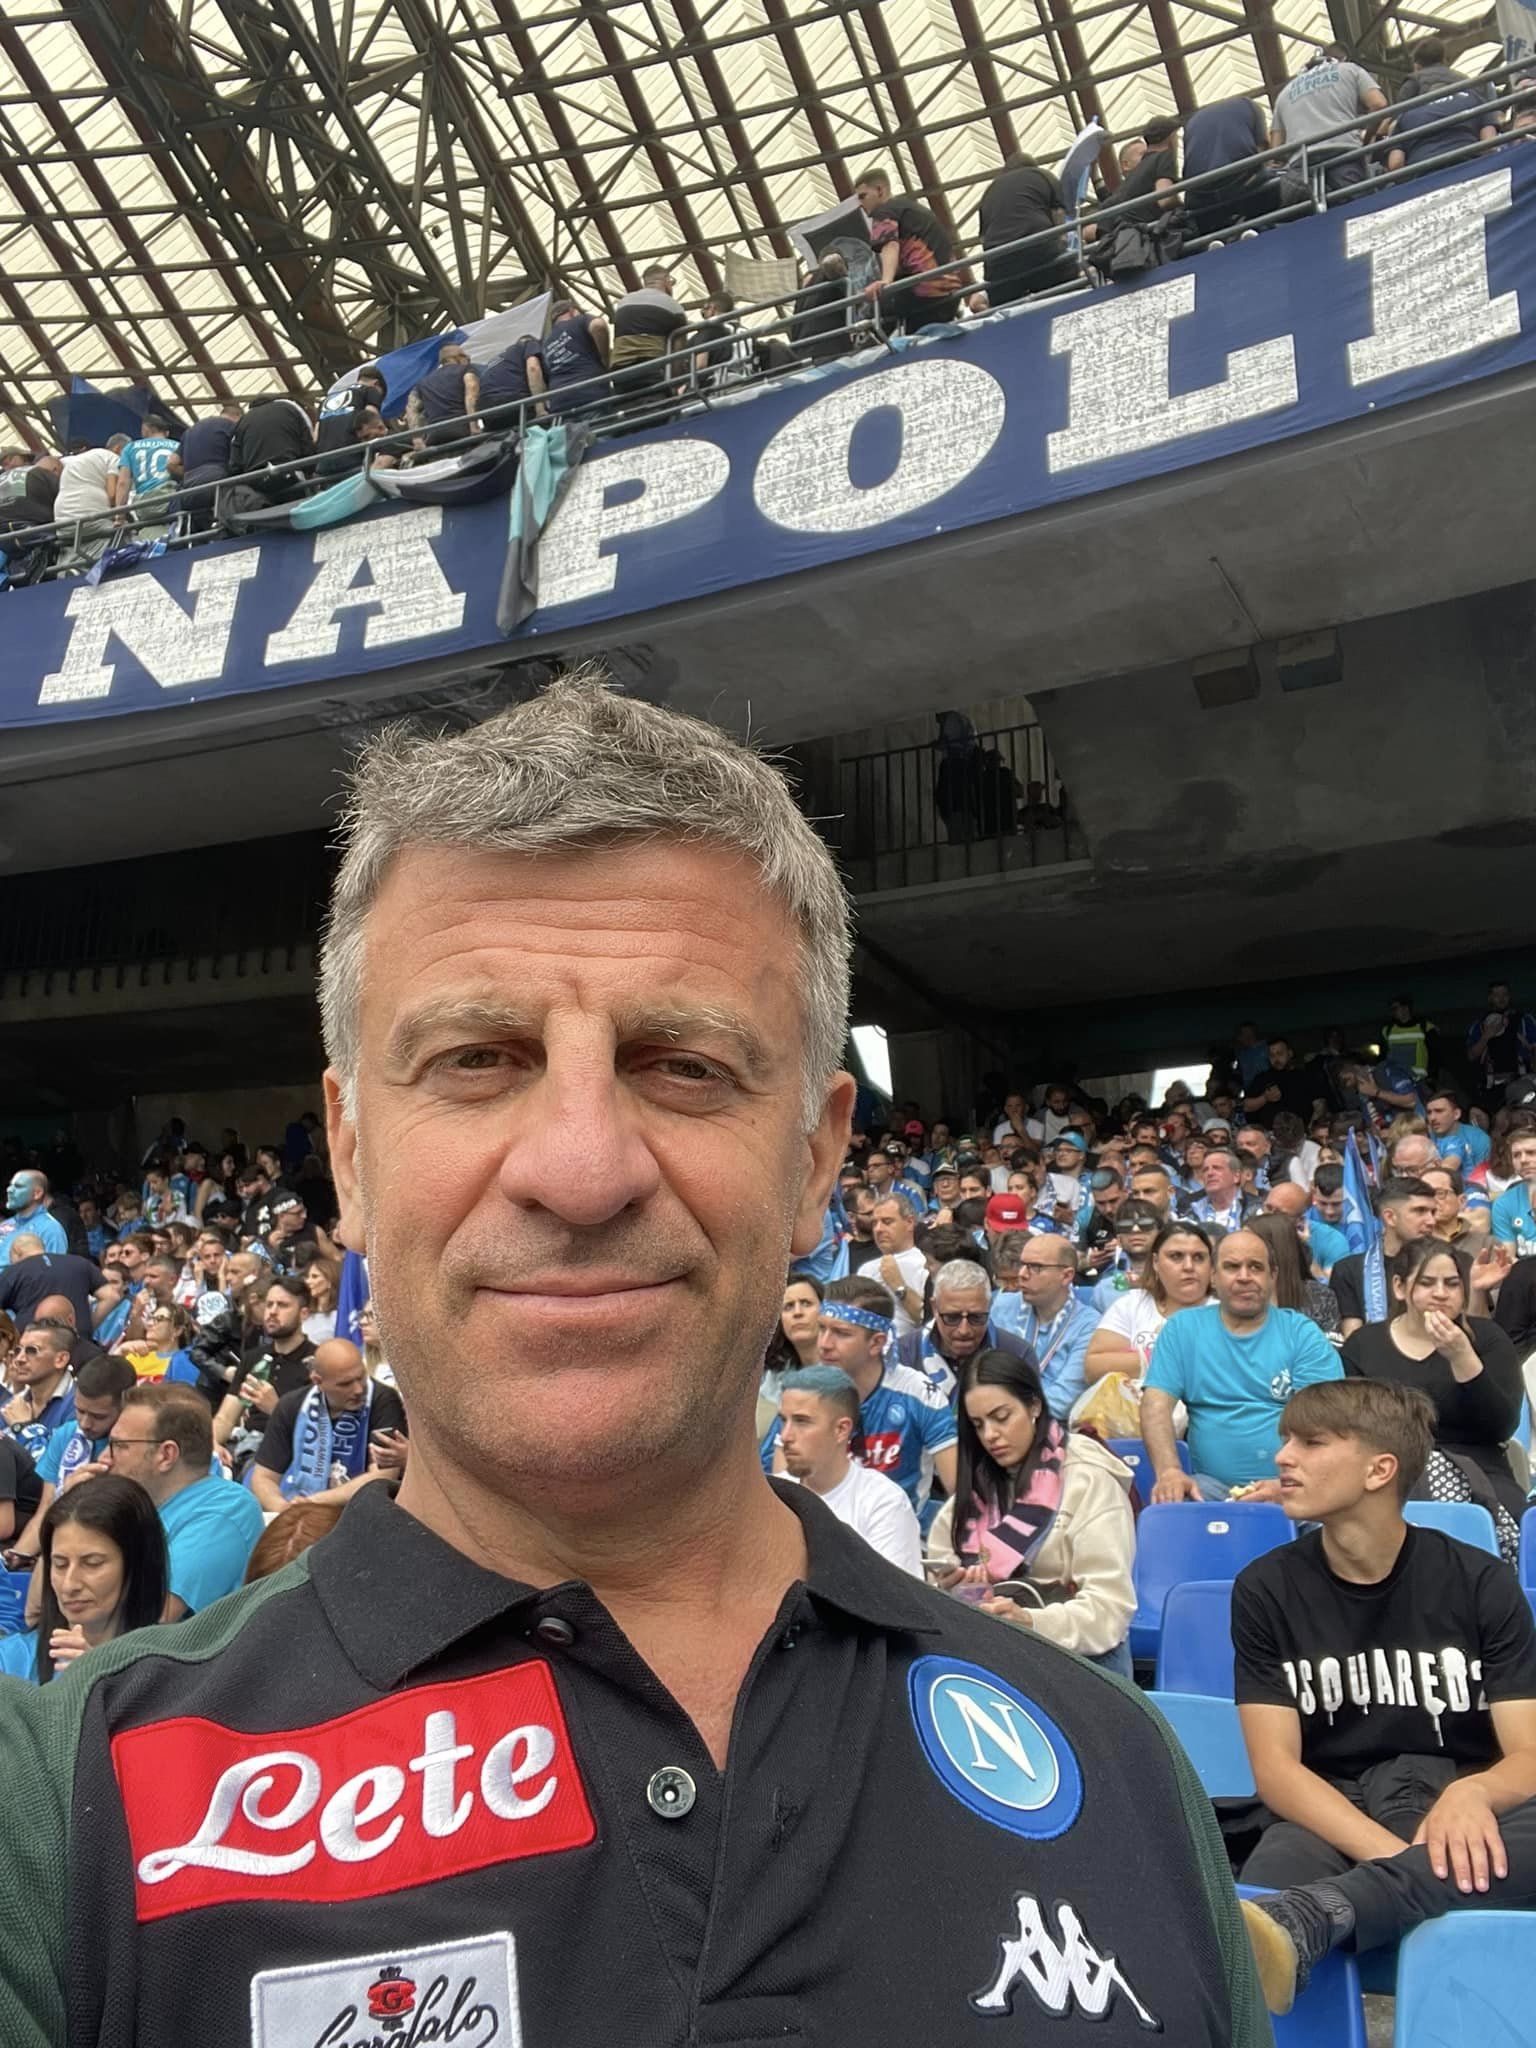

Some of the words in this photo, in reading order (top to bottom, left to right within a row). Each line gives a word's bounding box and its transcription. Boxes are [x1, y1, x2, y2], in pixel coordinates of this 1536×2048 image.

[38, 167, 1522, 705] NAPOLI
[135, 448, 173, 482] 10
[138, 1710, 558, 1885] Lete
[945, 1688, 1037, 1782] N
